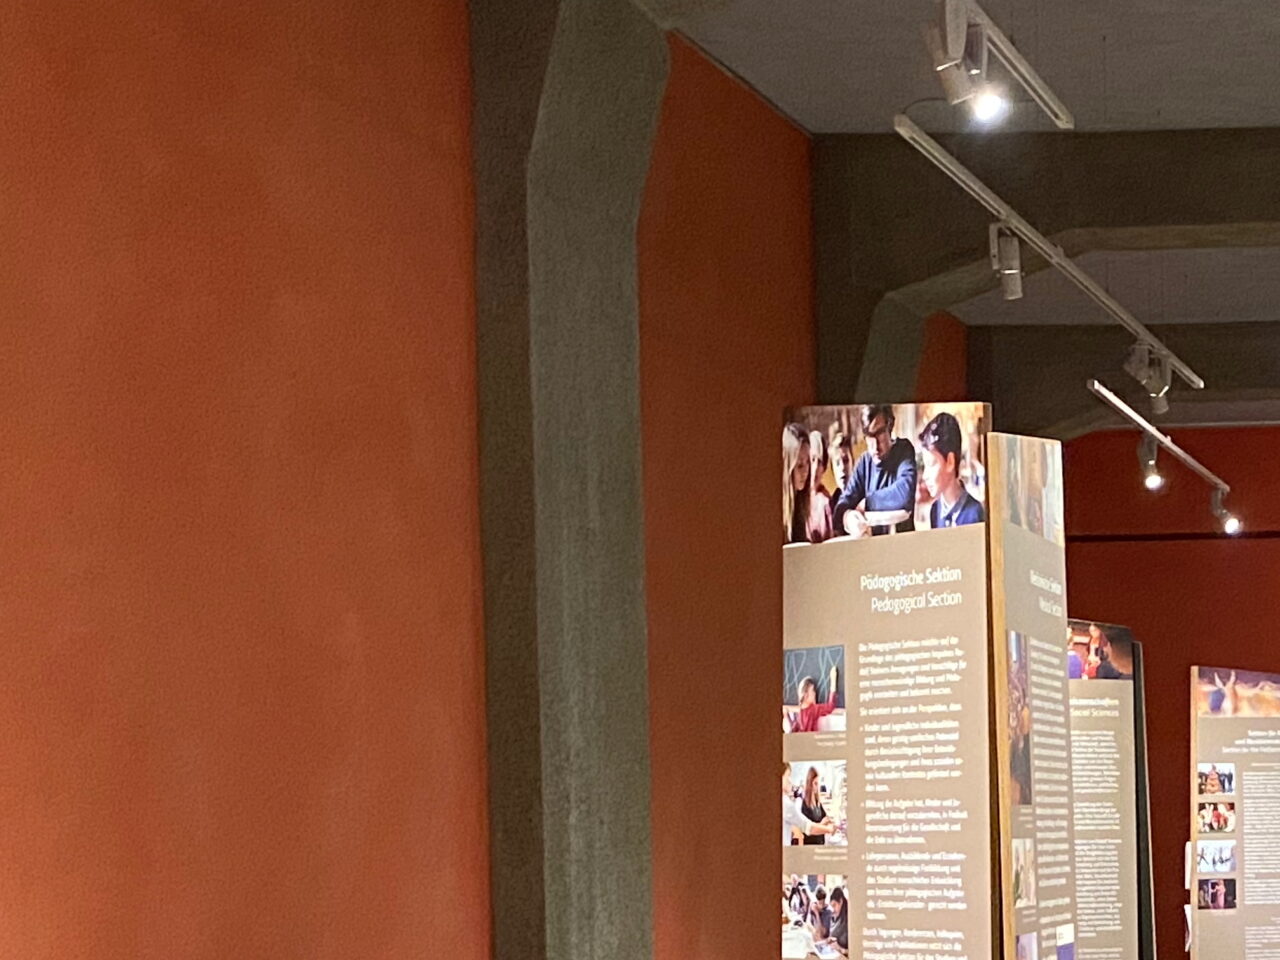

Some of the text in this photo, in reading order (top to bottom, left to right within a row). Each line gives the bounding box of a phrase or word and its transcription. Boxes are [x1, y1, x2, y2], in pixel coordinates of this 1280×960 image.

[860, 567, 962, 592] Pädagogische Sektion
[871, 591, 962, 615] Pedagogical Section
